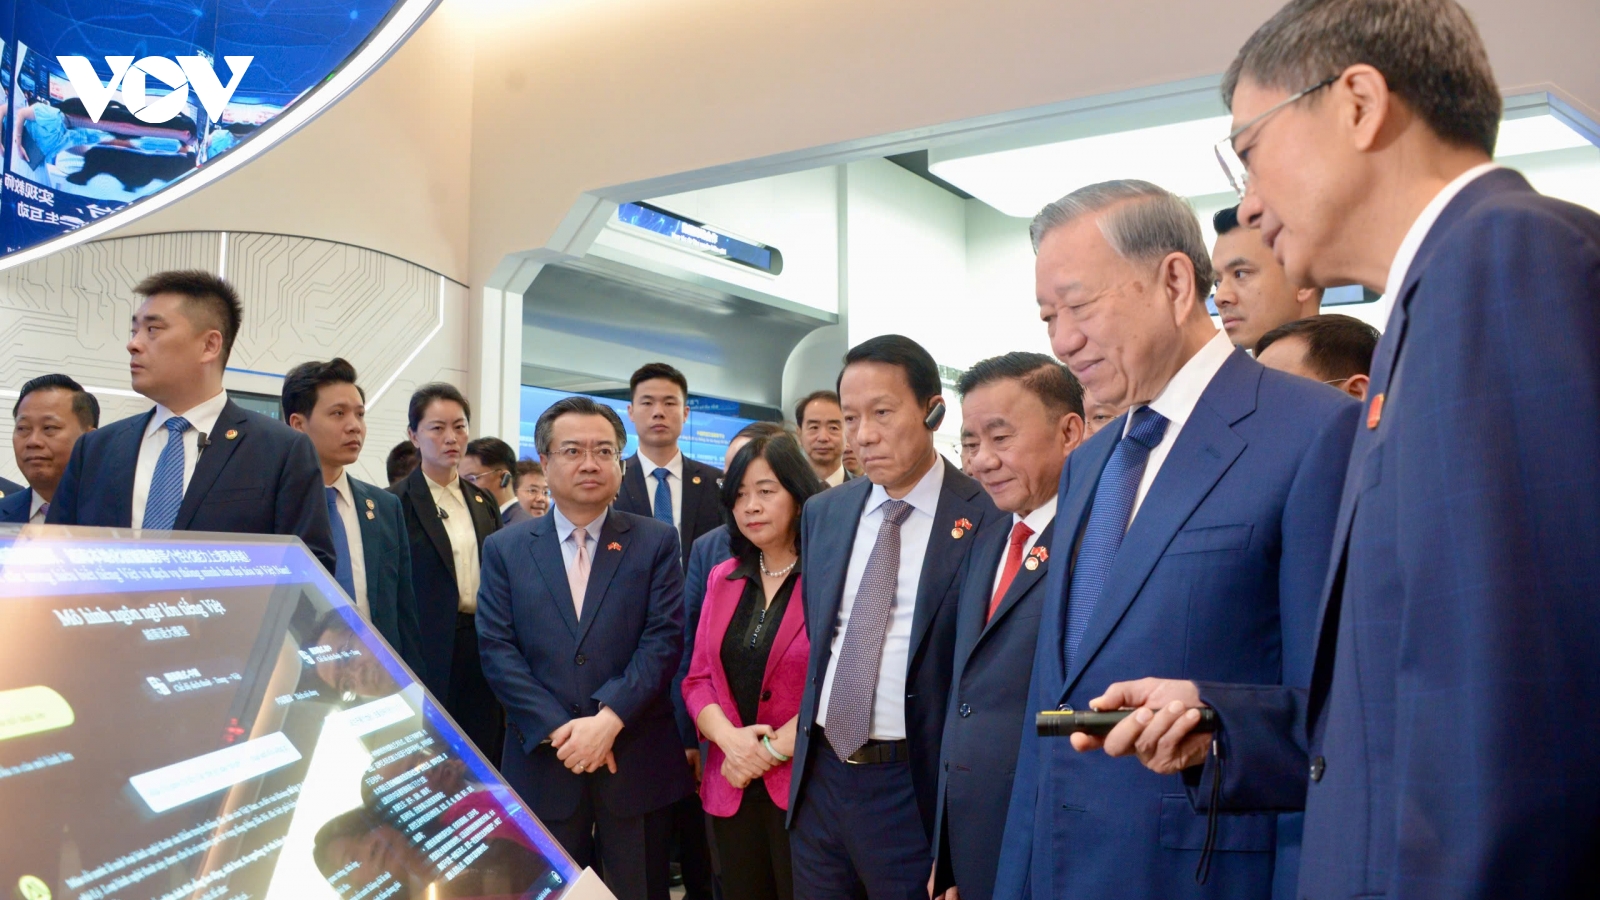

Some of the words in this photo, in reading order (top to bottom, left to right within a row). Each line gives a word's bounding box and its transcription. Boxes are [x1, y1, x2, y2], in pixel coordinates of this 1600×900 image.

[52, 608, 83, 627] Mô
[77, 606, 114, 624] hình
[111, 605, 142, 625] ngôn
[139, 602, 164, 622] ngữ
[159, 602, 182, 617] lớn
[178, 596, 209, 618] tiếng
[201, 599, 227, 616] Việt
